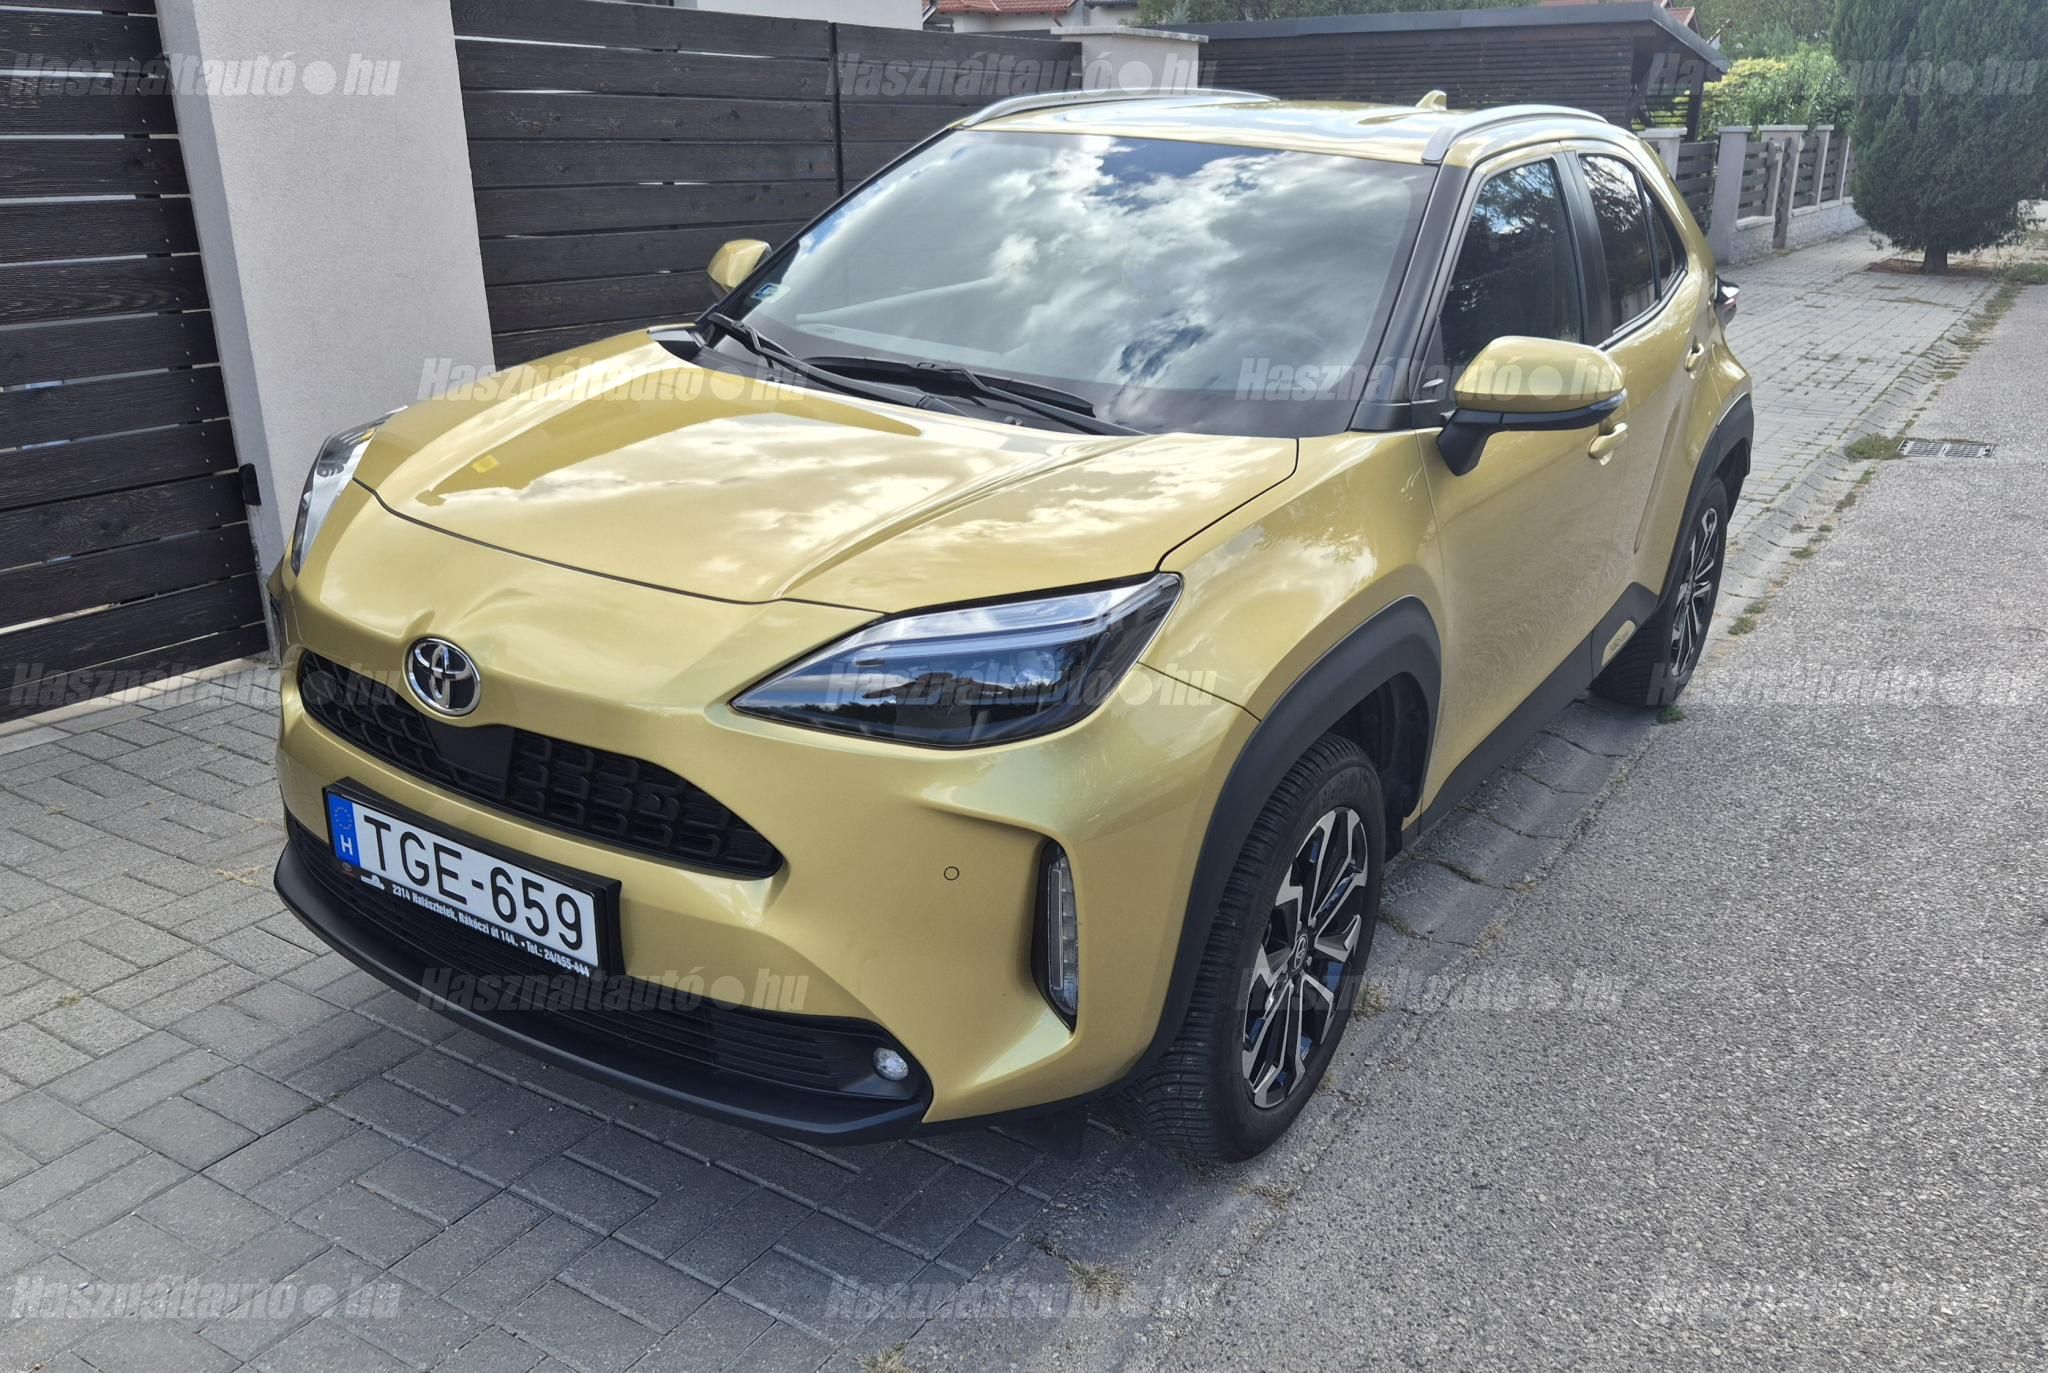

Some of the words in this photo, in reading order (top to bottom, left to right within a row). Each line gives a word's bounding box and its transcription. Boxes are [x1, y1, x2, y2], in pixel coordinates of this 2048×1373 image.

[340, 834, 353, 856] H
[364, 815, 583, 951] TGE-659
[392, 884, 411, 902] 2314
[458, 913, 490, 935] Rákóczi
[543, 948, 590, 978] 24/455-444
